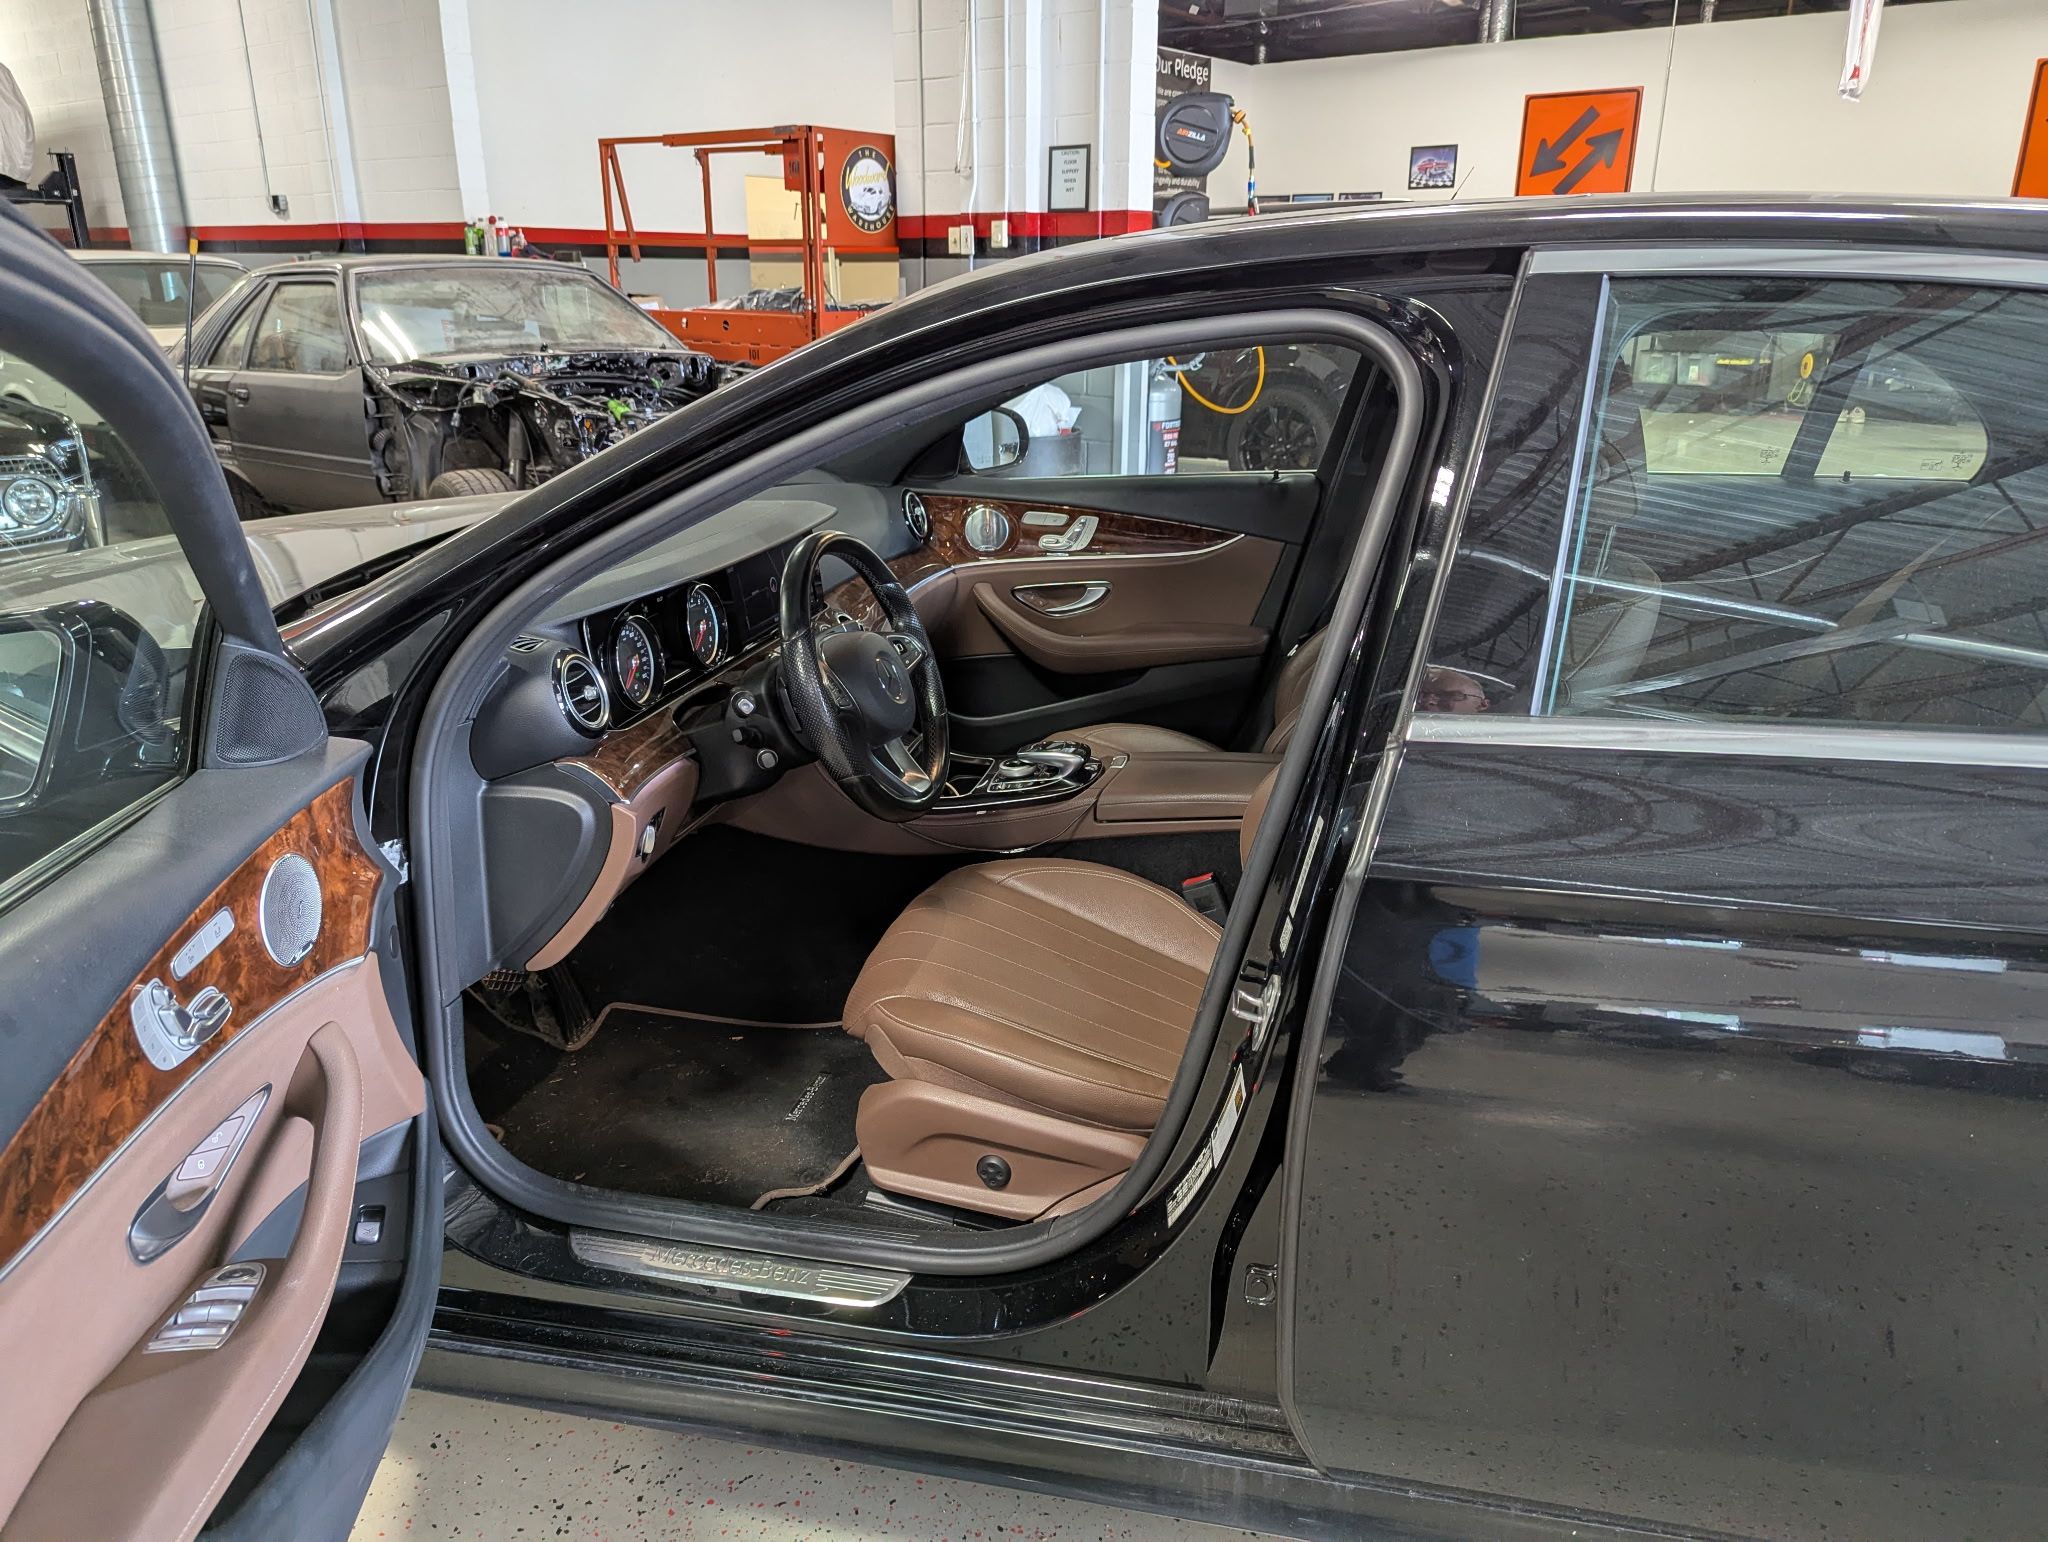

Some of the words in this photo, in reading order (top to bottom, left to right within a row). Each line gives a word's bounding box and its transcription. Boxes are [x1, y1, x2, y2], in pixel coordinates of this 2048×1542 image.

[1175, 58, 1209, 86] Pledge
[1176, 127, 1206, 142] AIRZILLA
[858, 149, 876, 158] THE
[847, 204, 895, 231] WAREHOUSE
[649, 1246, 811, 1285] Mercedes-Benz
